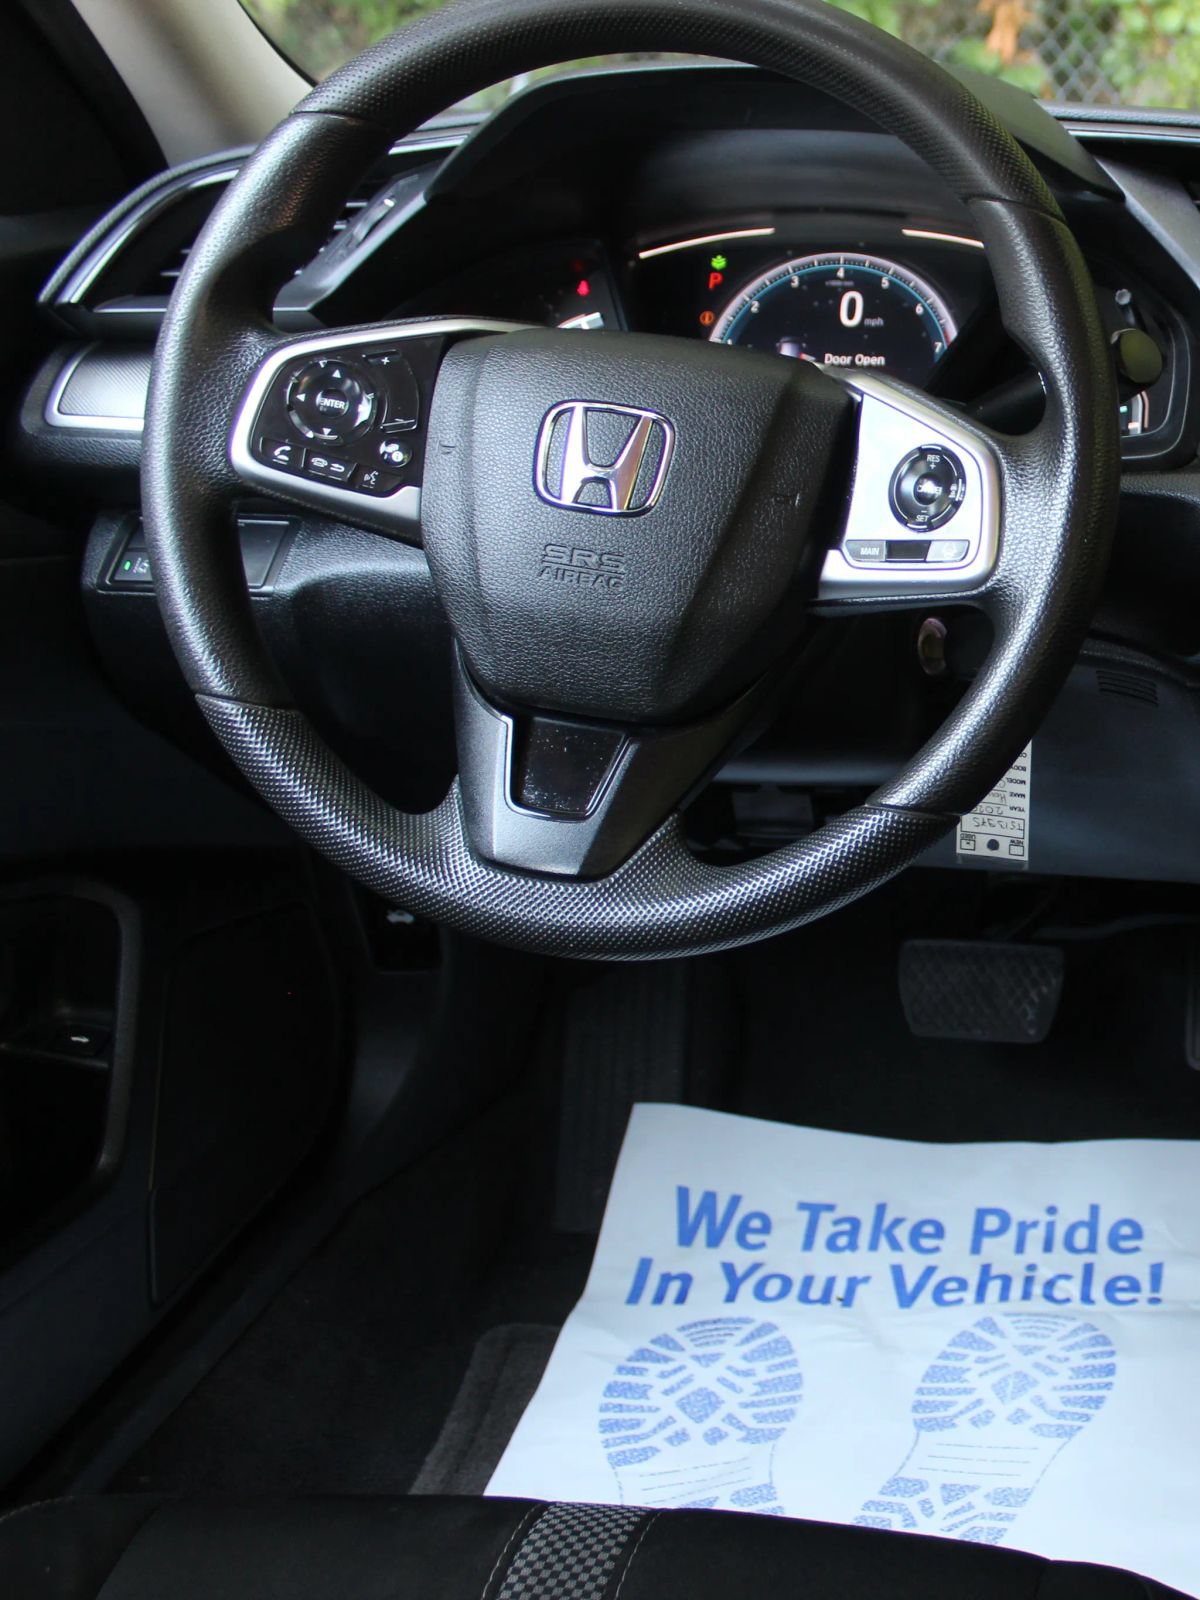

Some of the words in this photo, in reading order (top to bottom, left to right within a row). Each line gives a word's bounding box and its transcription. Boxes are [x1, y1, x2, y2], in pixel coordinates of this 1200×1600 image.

[708, 272, 724, 291] P
[790, 275, 800, 288] 3
[836, 267, 846, 279] 4
[881, 276, 890, 289] 5
[750, 301, 760, 314] 2
[915, 303, 924, 315] 6
[839, 290, 864, 328] 0
[864, 317, 884, 328] mph
[934, 342, 943, 353] 7
[824, 353, 852, 366] Door
[855, 353, 885, 368] Open
[319, 398, 346, 410] ENTER
[926, 454, 941, 463] RES
[915, 514, 929, 522] SET
[541, 543, 626, 572] SRS
[860, 547, 880, 556] MAIN
[539, 565, 625, 589] AIRBAG
[1006, 777, 1026, 786] MODEL
[675, 1184, 773, 1253] We
[796, 1201, 946, 1256] Take
[968, 1203, 1145, 1257] Pride
[624, 1257, 693, 1307] In
[719, 1261, 872, 1309] Your
[889, 1262, 1166, 1309] Vehicle!
